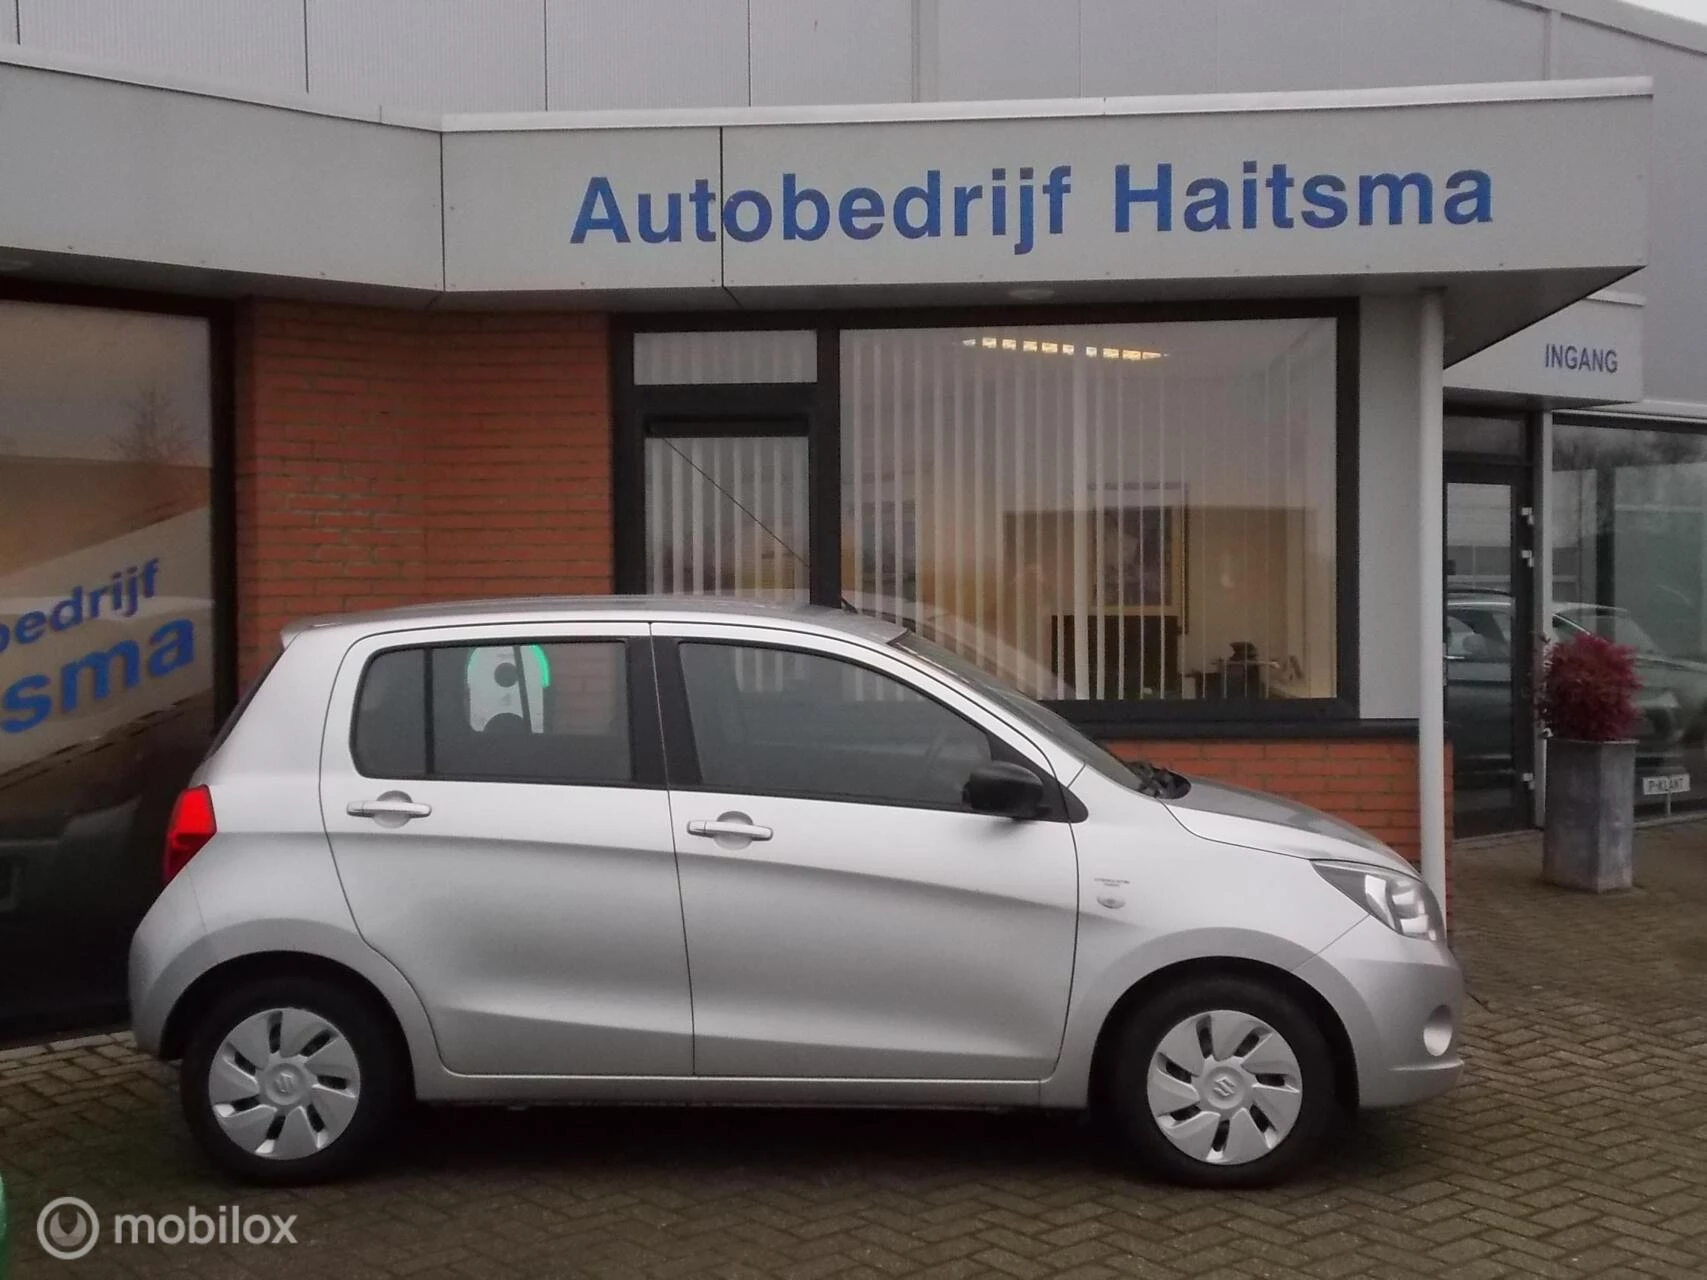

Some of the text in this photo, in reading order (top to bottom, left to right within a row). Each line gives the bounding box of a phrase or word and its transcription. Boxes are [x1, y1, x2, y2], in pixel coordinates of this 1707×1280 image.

[570, 160, 1494, 256] Autobedrijf Haitsma
[1544, 343, 1618, 374] INGANG
[0, 617, 196, 734] sma
